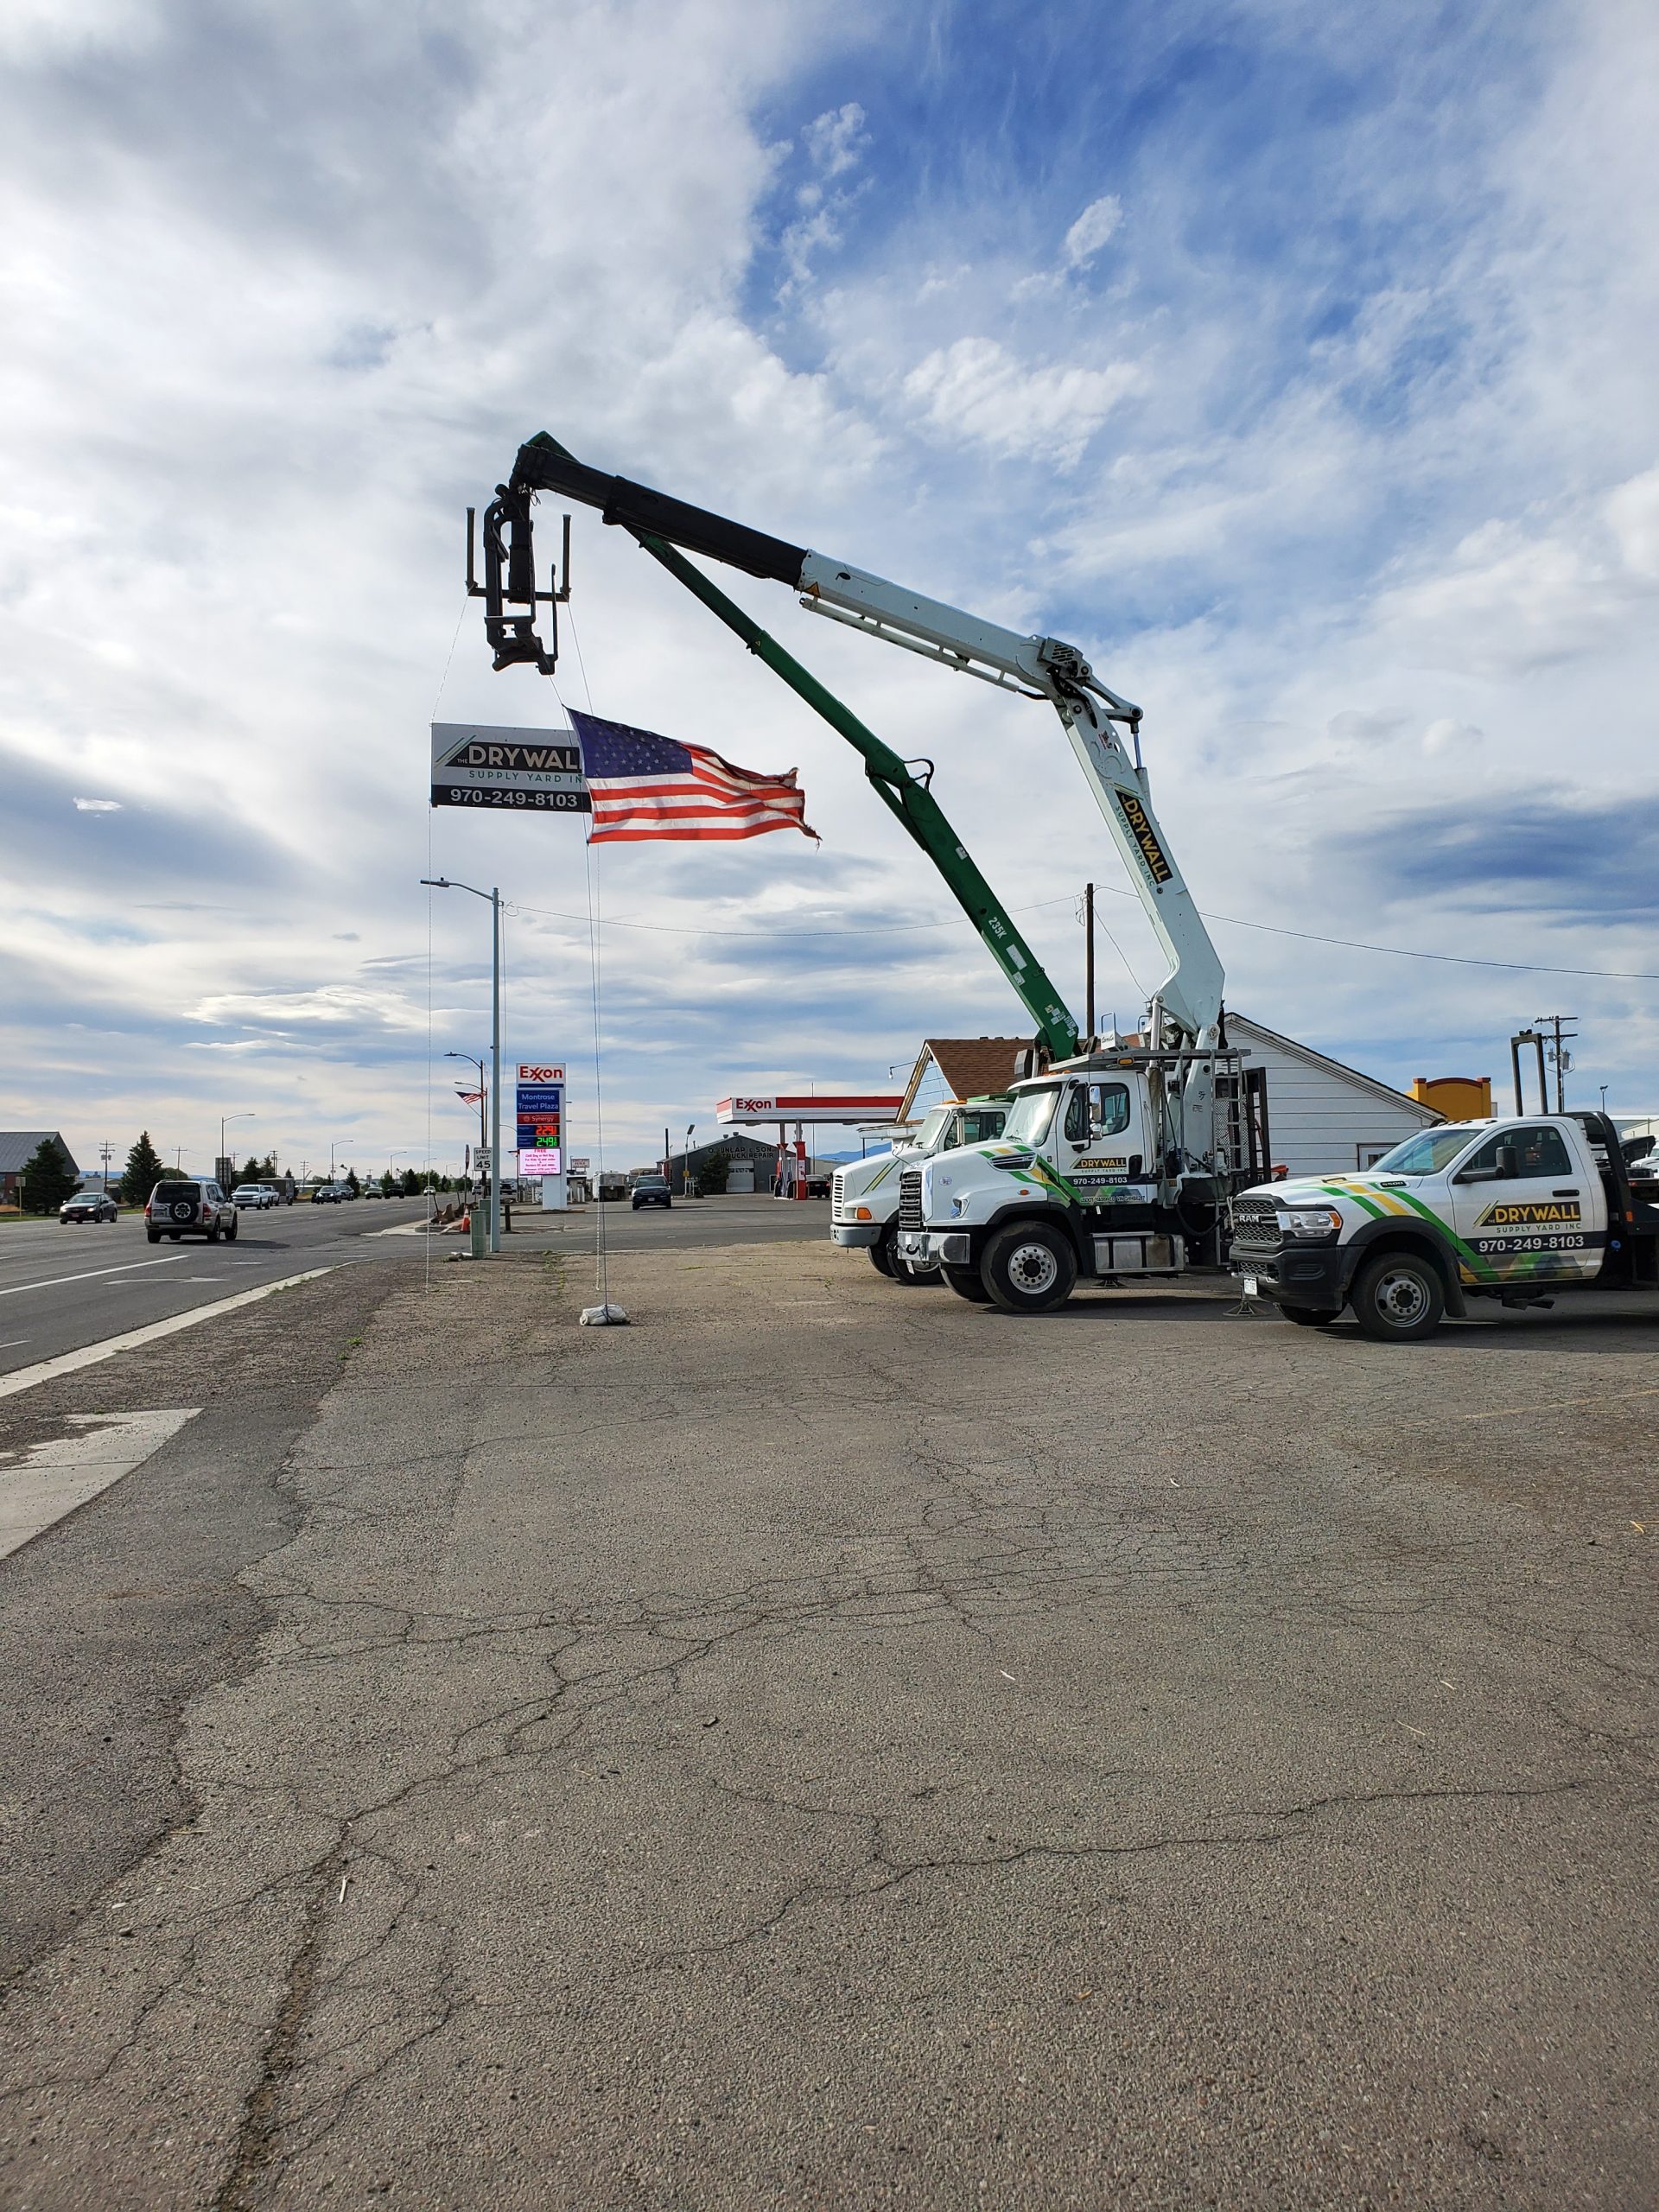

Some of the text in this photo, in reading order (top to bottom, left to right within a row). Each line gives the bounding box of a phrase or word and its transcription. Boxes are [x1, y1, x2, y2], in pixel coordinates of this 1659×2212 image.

[468, 745, 582, 770] DRYWAL
[469, 770, 582, 784] SUPPLY YARD IN
[450, 788, 577, 807] 970-249-8103
[1116, 805, 1134, 839] SUPPLY
[1133, 842, 1146, 867] YARD
[1145, 870, 1155, 887] INC
[1124, 799, 1168, 882] DRYWALL
[988, 917, 1007, 939] 235K
[520, 1066, 563, 1083] Exxon
[736, 1098, 772, 1112] Exxon
[1081, 1159, 1127, 1167] DRYWALL
[1495, 1205, 1580, 1223] DRYWALL
[1479, 1236, 1585, 1252] 970-249-8103
